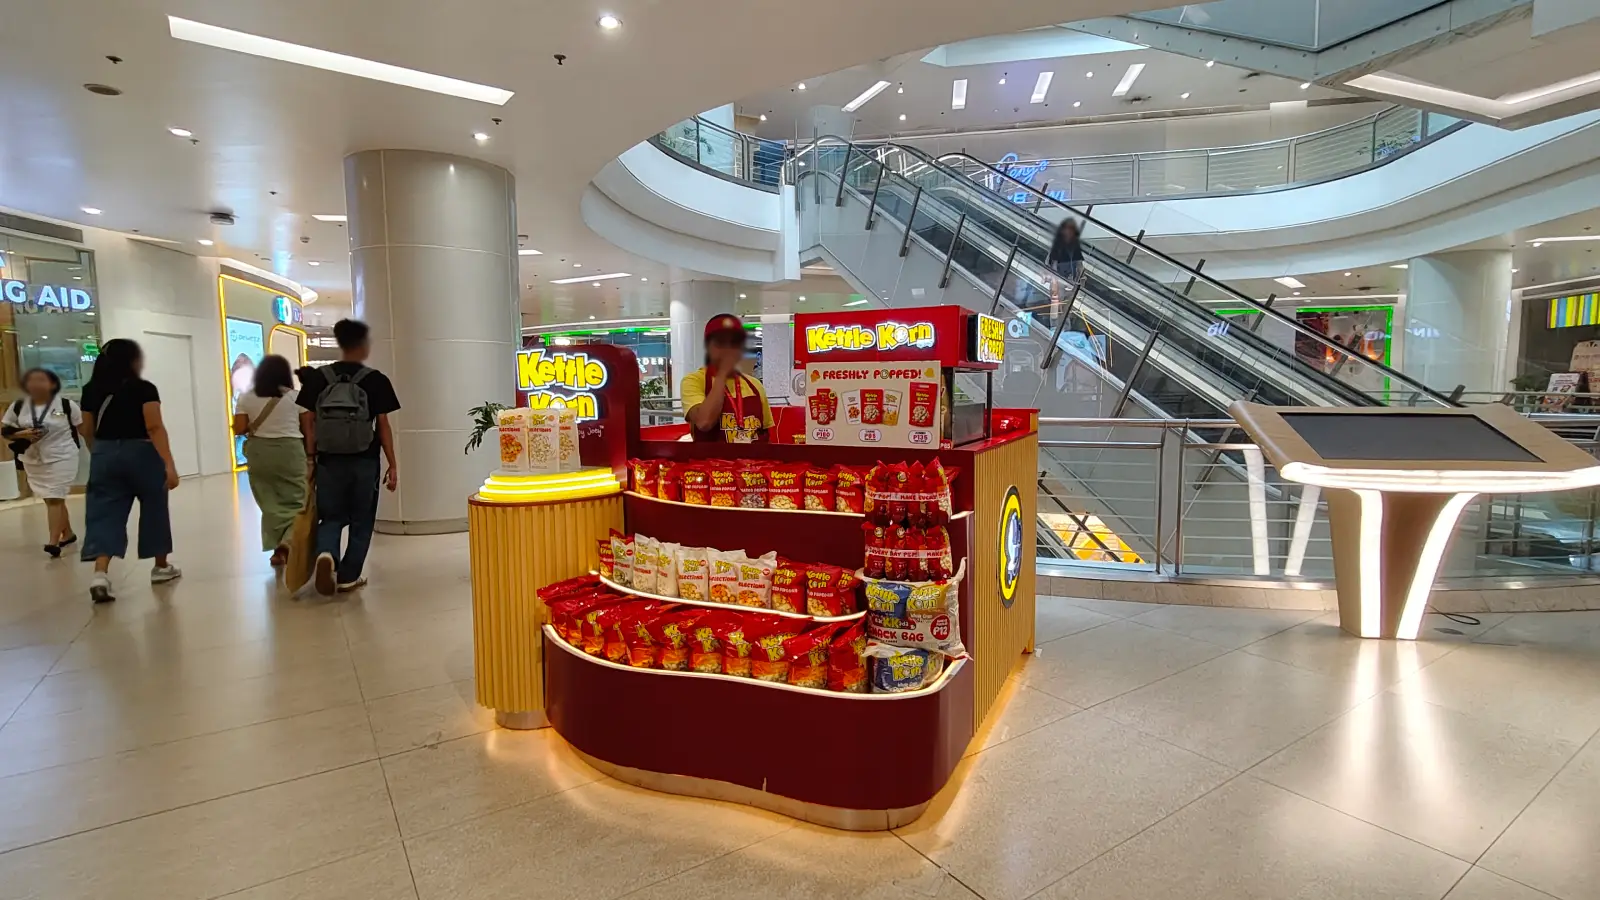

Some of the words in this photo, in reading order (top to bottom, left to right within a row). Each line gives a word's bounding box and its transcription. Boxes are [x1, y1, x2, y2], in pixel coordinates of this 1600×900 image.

[0, 280, 27, 303] G
[38, 285, 91, 310] AID
[980, 315, 1005, 340] FRESHLY
[806, 324, 875, 353] Kettle
[876, 322, 934, 350] Korn
[516, 350, 607, 390] Kettle
[823, 369, 869, 380] FRESHLY
[720, 412, 761, 429] Ketle
[773, 478, 793, 487] Korn
[774, 575, 792, 585] Korn
[906, 597, 937, 610] Korn
[901, 632, 925, 641] BAG
